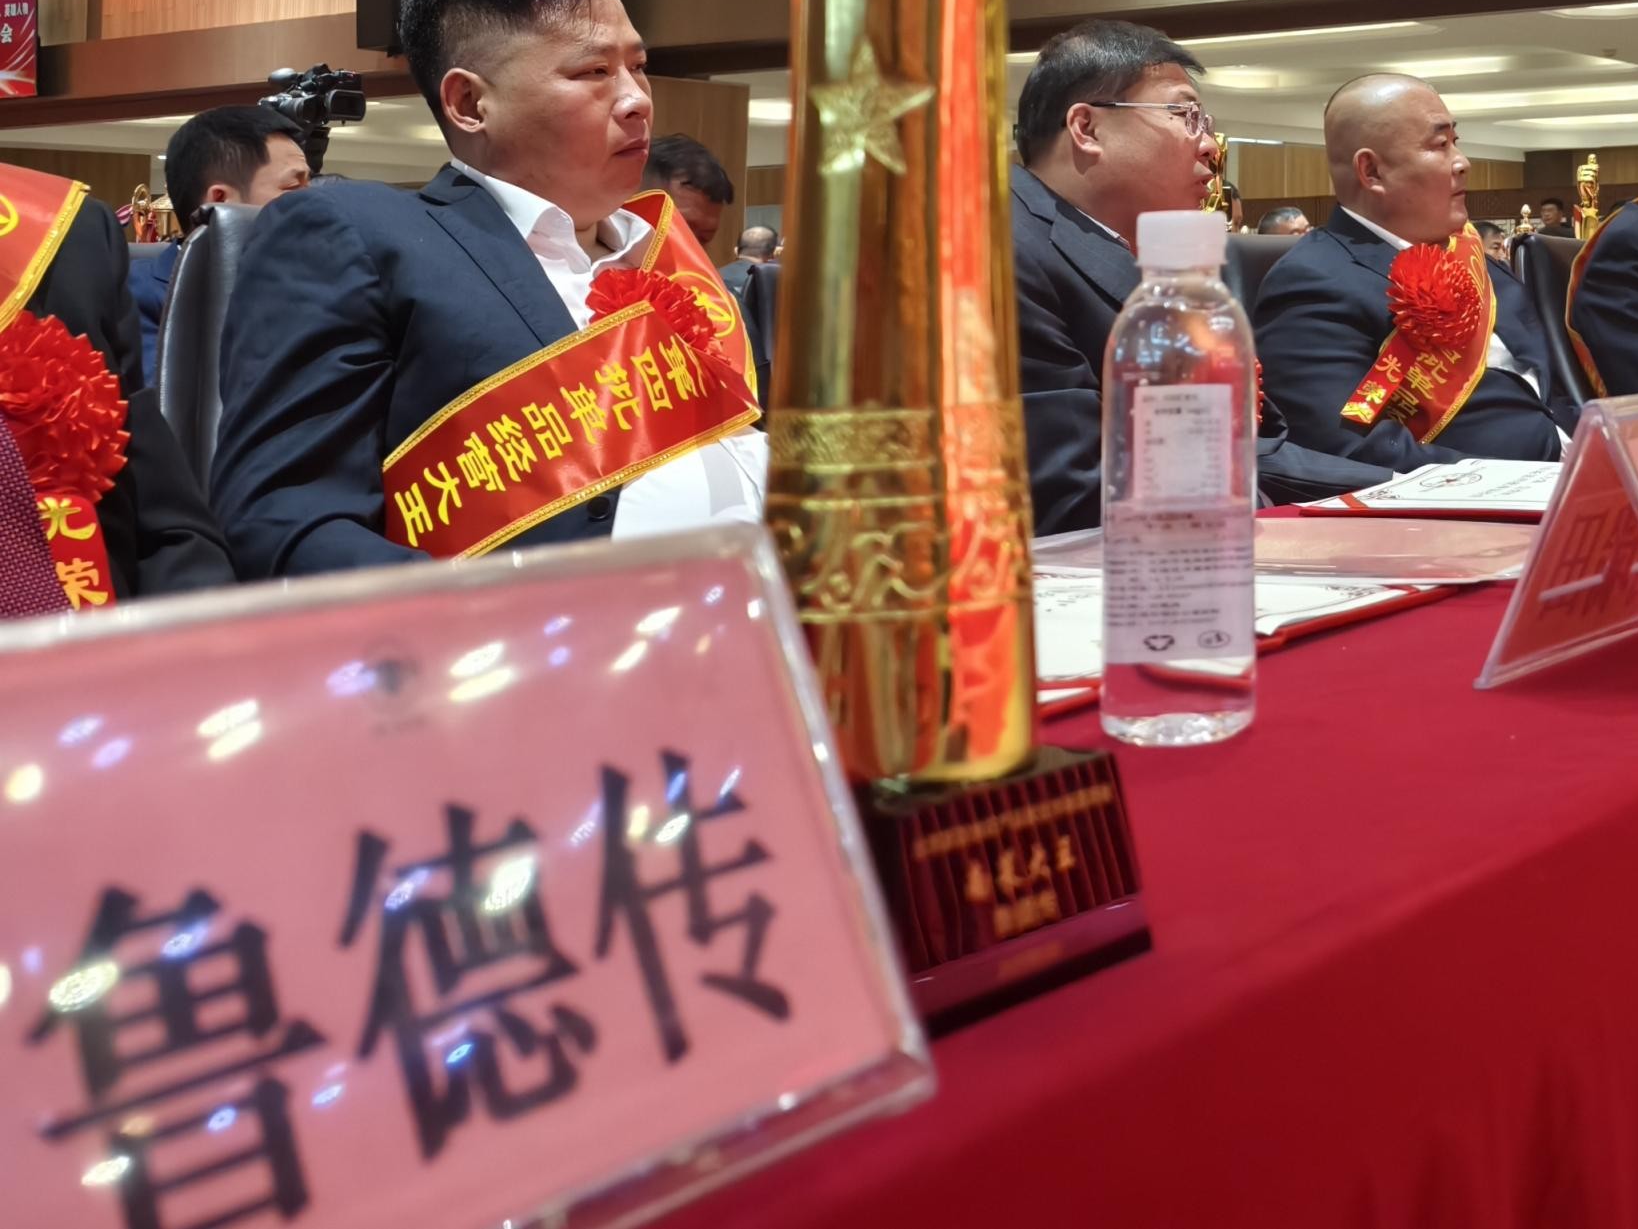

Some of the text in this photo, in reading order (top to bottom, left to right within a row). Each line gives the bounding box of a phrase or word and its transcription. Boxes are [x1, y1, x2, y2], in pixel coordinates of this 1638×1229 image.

[1, 23, 13, 43] 会
[394, 335, 708, 547] 第四批单品经营大王
[37, 496, 109, 611] 光荣
[22, 746, 793, 1229] 鲁德传
